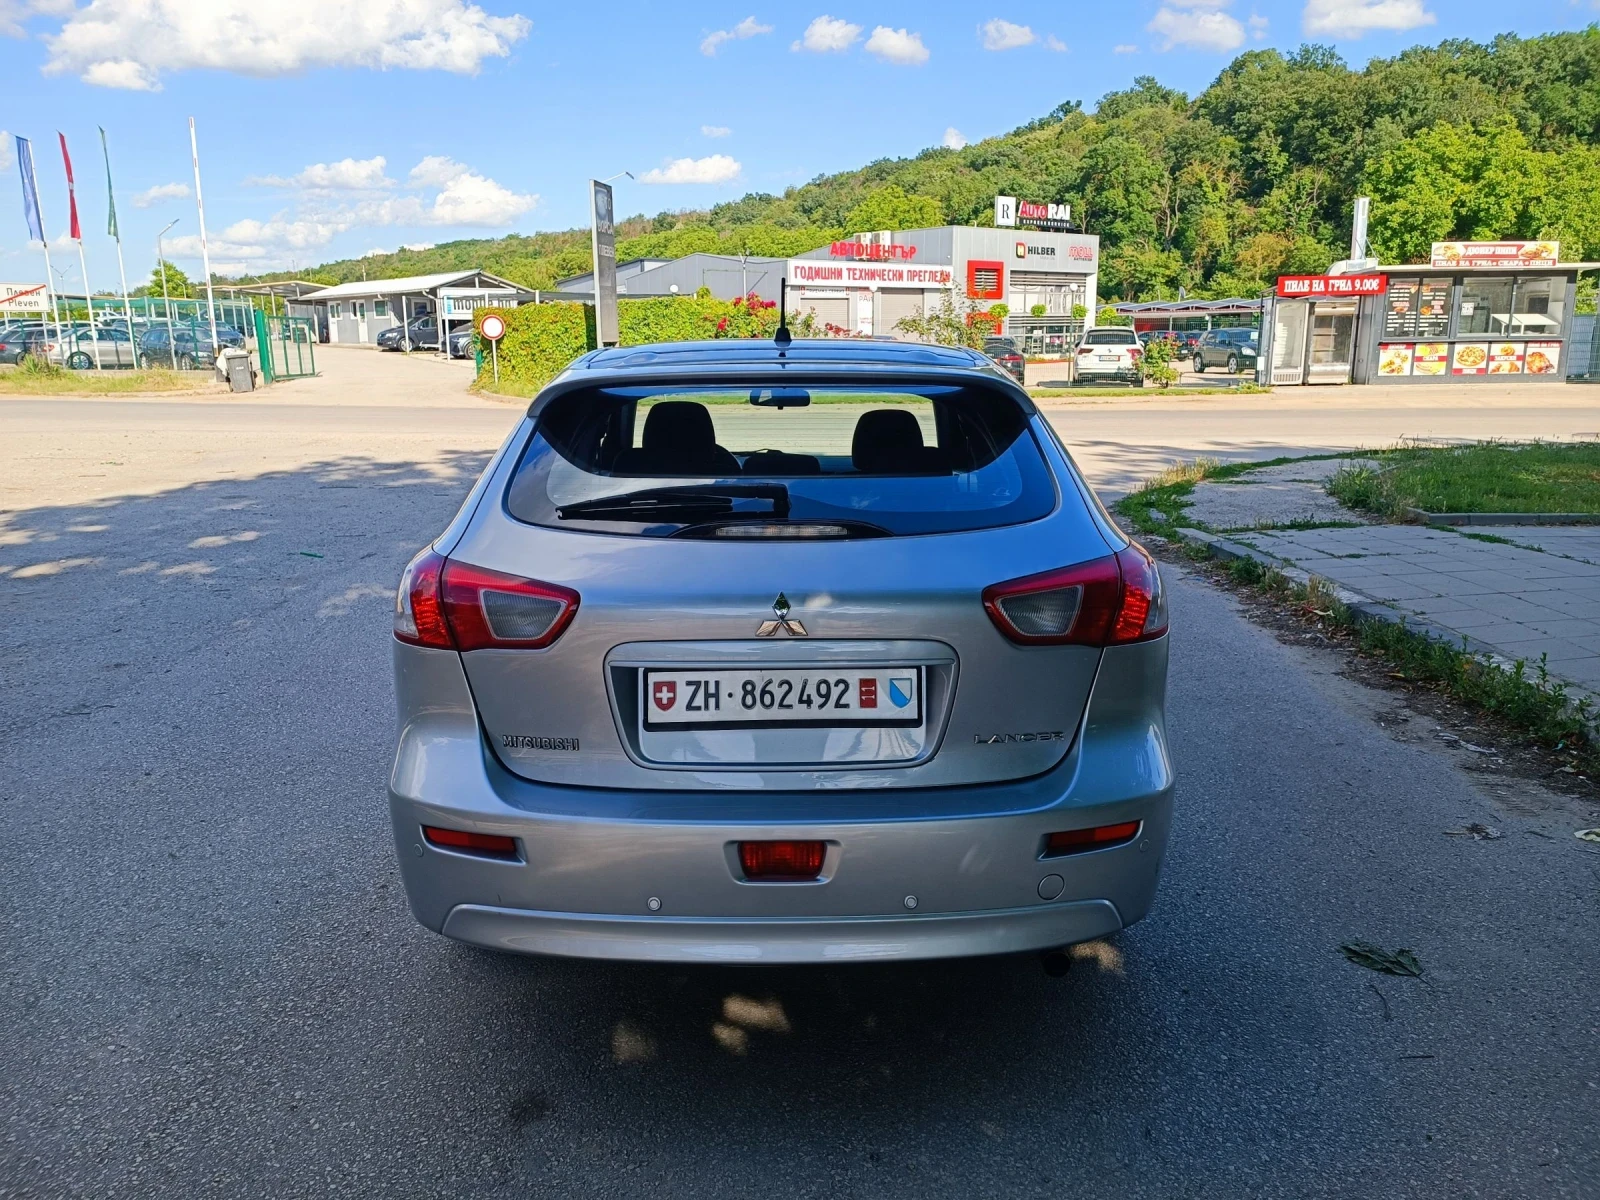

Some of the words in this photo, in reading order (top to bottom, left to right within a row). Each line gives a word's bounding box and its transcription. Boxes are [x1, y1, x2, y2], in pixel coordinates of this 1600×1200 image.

[1002, 203, 1010, 219] R
[829, 241, 917, 259] АВТОЦЕНТЪР
[1028, 246, 1056, 256] HILBER
[794, 265, 843, 281] ГОДИШНИ
[846, 267, 904, 282] ТЕХНИЧЕСКИ
[1284, 280, 1310, 293] ПИЛЕ
[1312, 280, 1325, 292] НА
[1328, 279, 1352, 292] ГРИЛ
[1354, 278, 1380, 291] 9.00€
[9, 299, 40, 307] Pleven
[685, 681, 720, 711] ZH
[741, 678, 850, 710] 862492
[502, 735, 580, 751] MITSUBISHI
[974, 731, 1065, 744] LANCER
